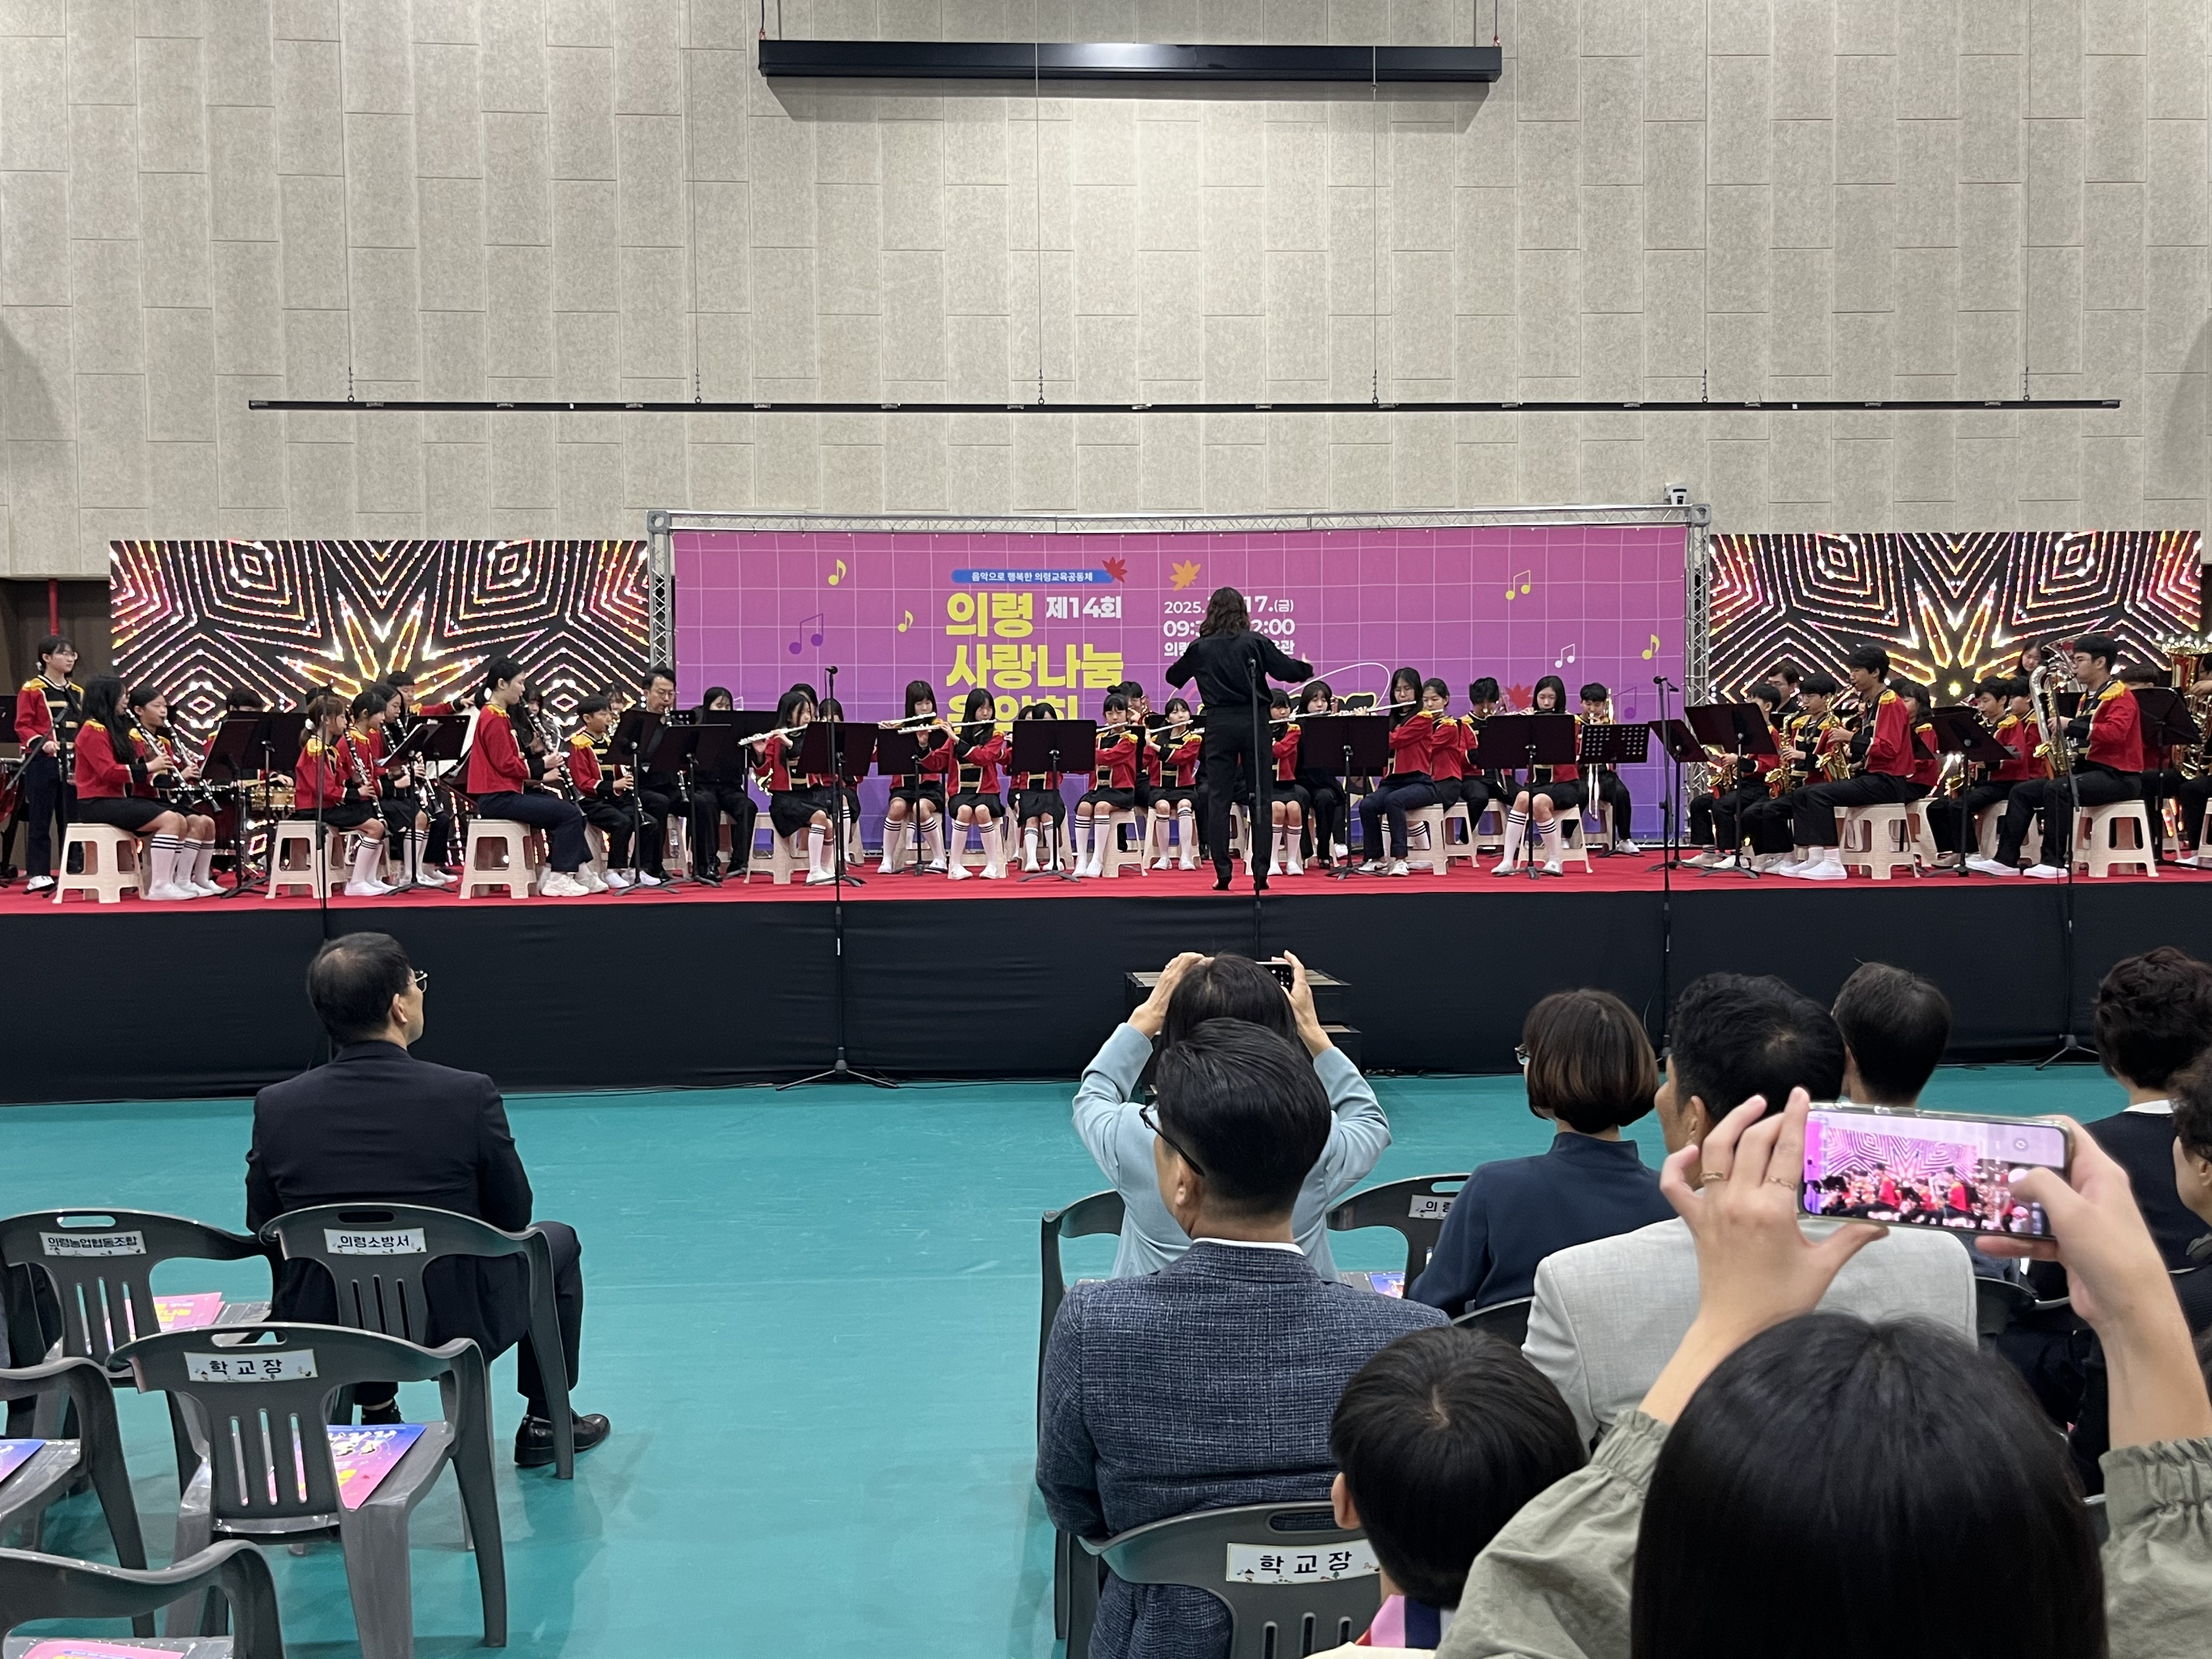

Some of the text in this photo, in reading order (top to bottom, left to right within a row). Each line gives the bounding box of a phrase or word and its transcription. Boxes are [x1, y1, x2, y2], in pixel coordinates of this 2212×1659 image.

[972, 572, 1093, 582] 음악으로 행복한 의령교육공동체
[946, 592, 1034, 638] 의령
[1046, 596, 1122, 619] 제14회
[1164, 601, 1206, 613] 2025.
[946, 643, 1124, 689] 사랑나눔
[340, 1235, 409, 1248] 의령소방서
[209, 1359, 283, 1375] 학교장
[1260, 1551, 1352, 1575] 학교장
